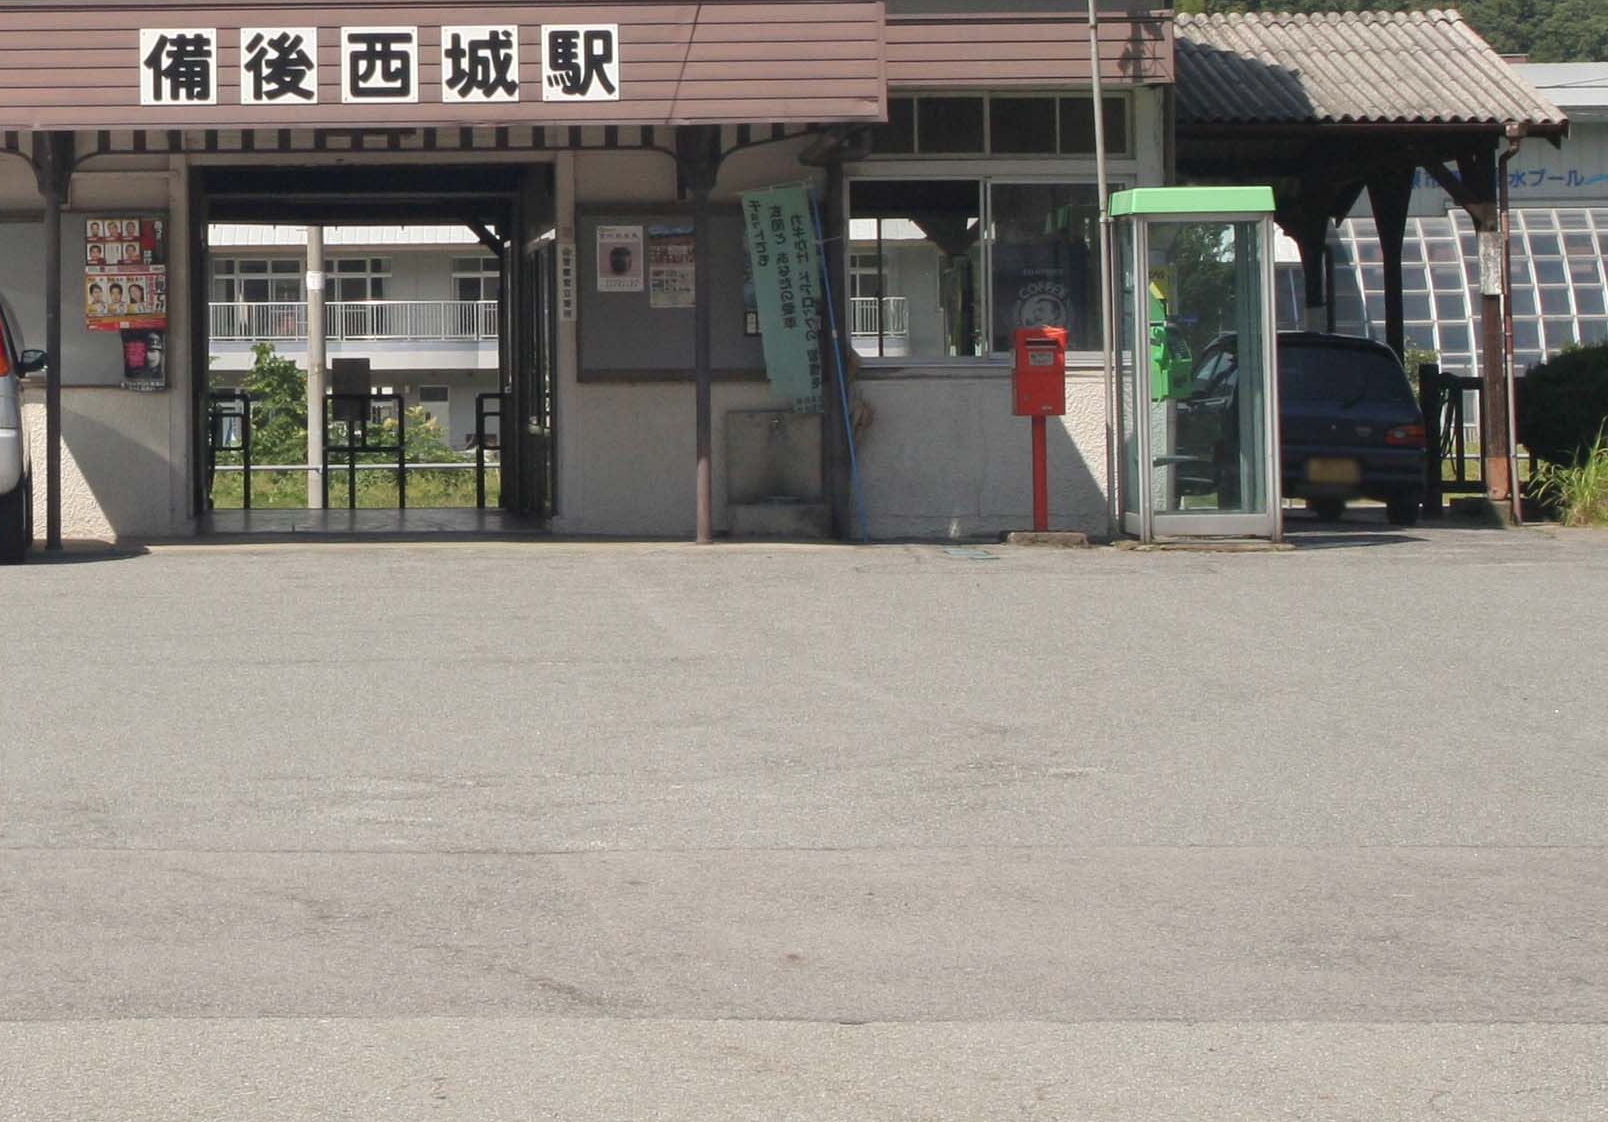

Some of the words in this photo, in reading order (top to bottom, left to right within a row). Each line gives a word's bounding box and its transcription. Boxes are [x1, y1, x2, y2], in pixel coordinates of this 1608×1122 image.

[143, 29, 617, 101] 備後西城駅
